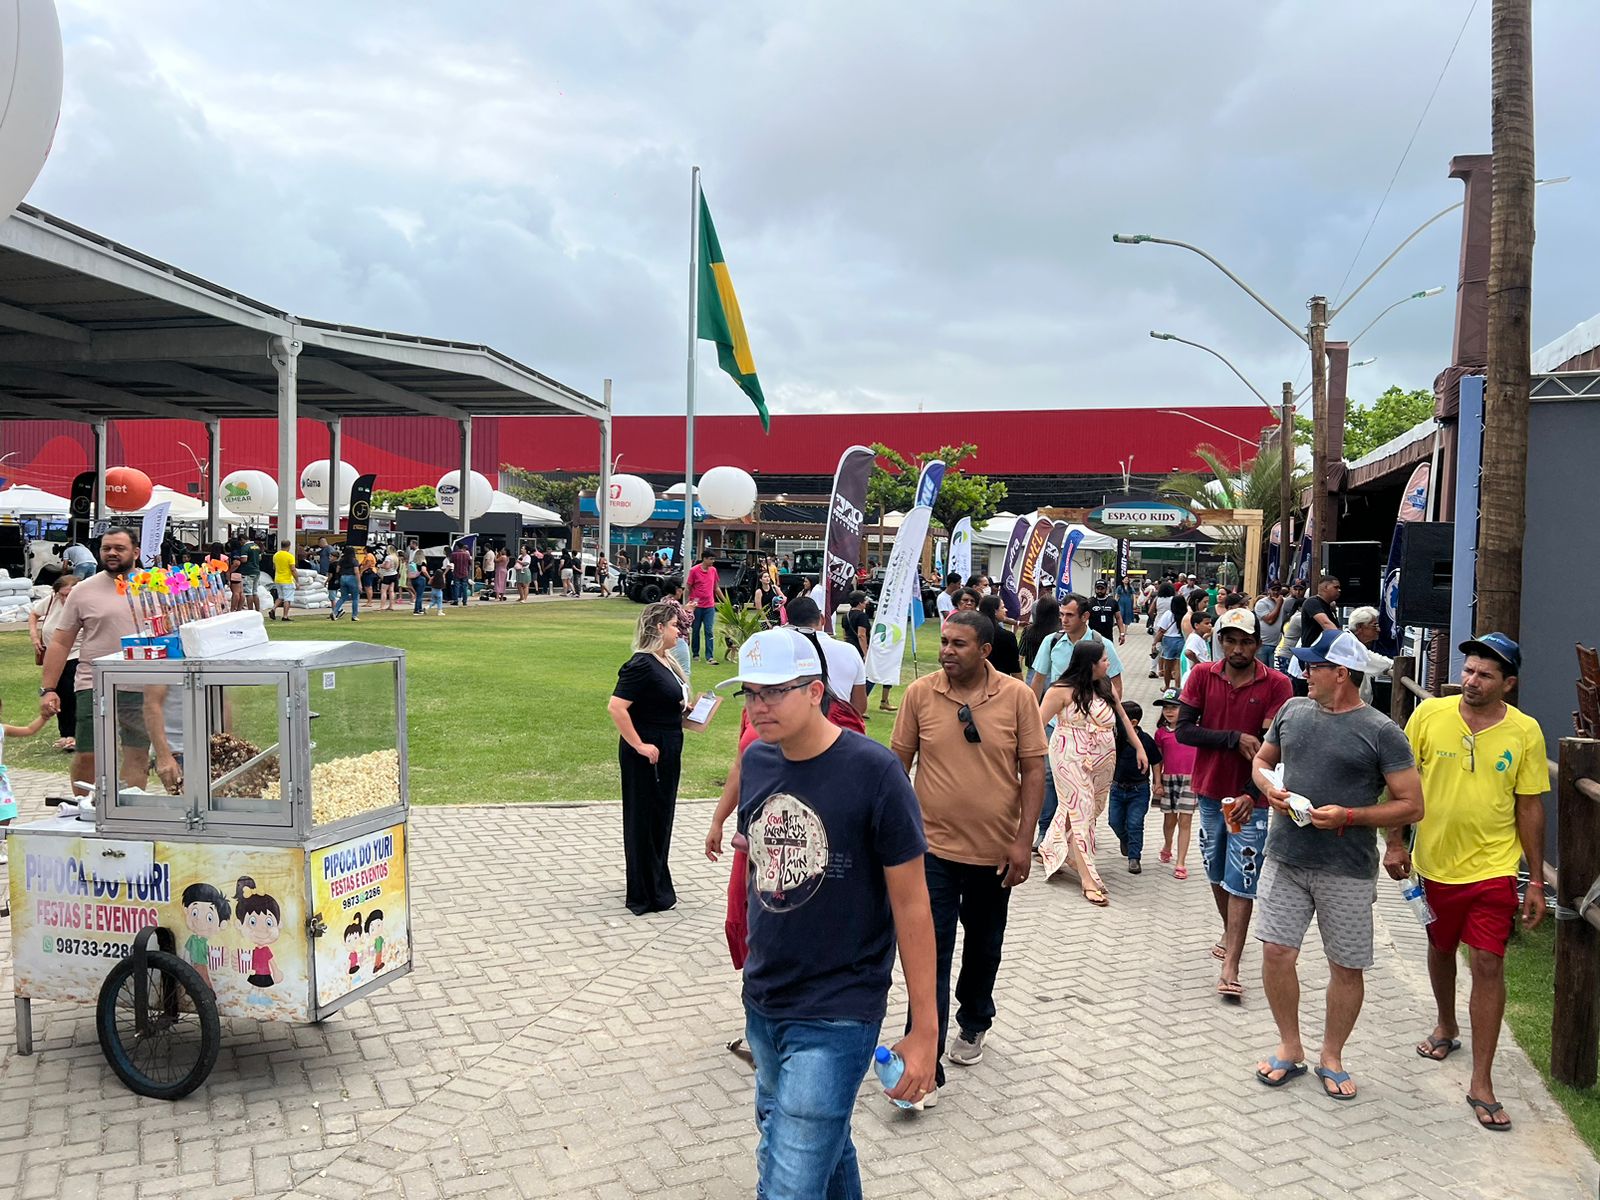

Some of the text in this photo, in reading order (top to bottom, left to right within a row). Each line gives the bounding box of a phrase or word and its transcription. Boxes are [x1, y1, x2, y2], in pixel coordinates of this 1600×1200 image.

[306, 478, 321, 488] Gama
[1108, 512, 1175, 522] ESPAÇO KIDS
[324, 834, 393, 880] PIPOCA DO YURI
[26, 854, 88, 896] PIPOCA
[126, 863, 169, 902] YURI
[331, 862, 388, 898] FESTAS E EVENTOS
[37, 900, 158, 934] FESTAS E EVENTOS
